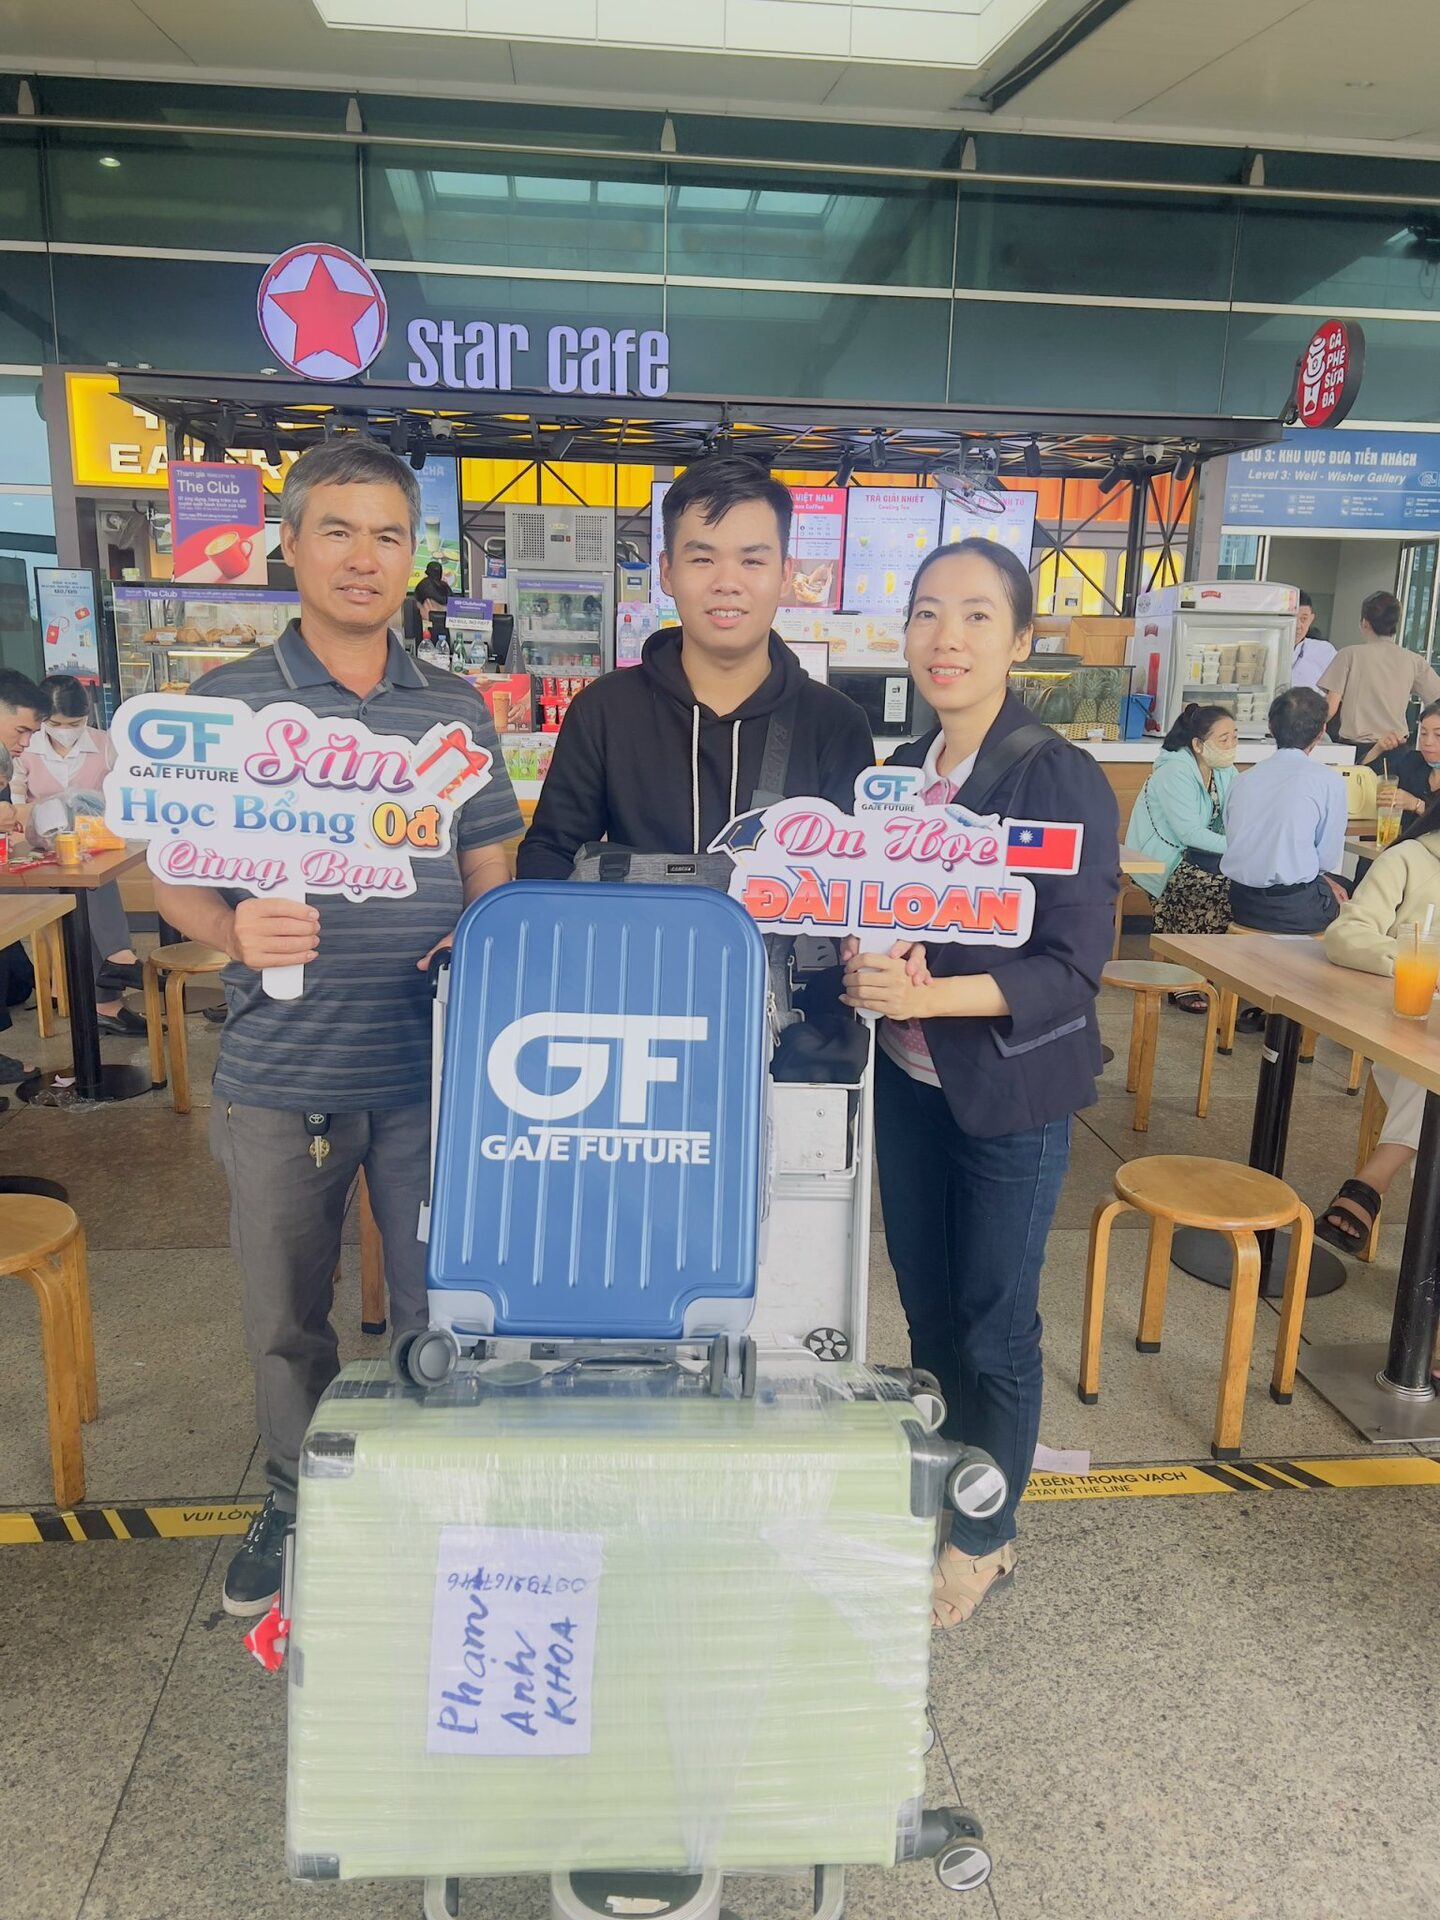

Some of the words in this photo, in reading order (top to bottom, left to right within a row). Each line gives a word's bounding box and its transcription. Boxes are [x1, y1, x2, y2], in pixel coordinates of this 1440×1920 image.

[1264, 450, 1275, 463] 3:
[1278, 449, 1301, 464] KHU
[1381, 450, 1417, 467] KHÁCH
[176, 480, 204, 494] The
[206, 480, 240, 495] Club
[1248, 469, 1279, 479] Level
[1281, 471, 1291, 480] 3:
[1294, 470, 1318, 481] Well
[1327, 471, 1365, 483] Wisher
[1367, 471, 1406, 486] Gallery
[815, 493, 835, 503] NAM
[159, 590, 178, 598] Club
[127, 708, 234, 763] GF
[243, 718, 416, 793] Săn
[129, 762, 173, 779] GATE
[175, 769, 239, 783] FUTURE
[863, 774, 916, 802] GF
[119, 786, 216, 835] Học
[232, 789, 356, 844] Bổng
[861, 802, 883, 811] GATE
[883, 803, 915, 813] FUTURE
[773, 811, 868, 860] Du
[884, 815, 999, 873] Học
[157, 839, 289, 890] Cùng
[299, 849, 407, 895] Bạn
[741, 864, 852, 928] ĐÀI
[857, 879, 1024, 937] LOAN
[486, 1011, 709, 1124] GF
[480, 1126, 571, 1161] GATE
[579, 1136, 711, 1165] FUTURE
[1027, 1488, 1057, 1497] STAY
[1061, 1487, 1074, 1495] IN
[1080, 1486, 1103, 1494] THE
[1105, 1485, 1133, 1493] LINE
[1040, 1473, 1076, 1487] BÊN
[1076, 1473, 1138, 1485] TRONG
[1138, 1471, 1187, 1484] VẠCH
[183, 1511, 214, 1522] VUI
[437, 1593, 498, 1735] Phạm
[544, 1616, 578, 1725] KHOA
[500, 1630, 538, 1736] Anh
